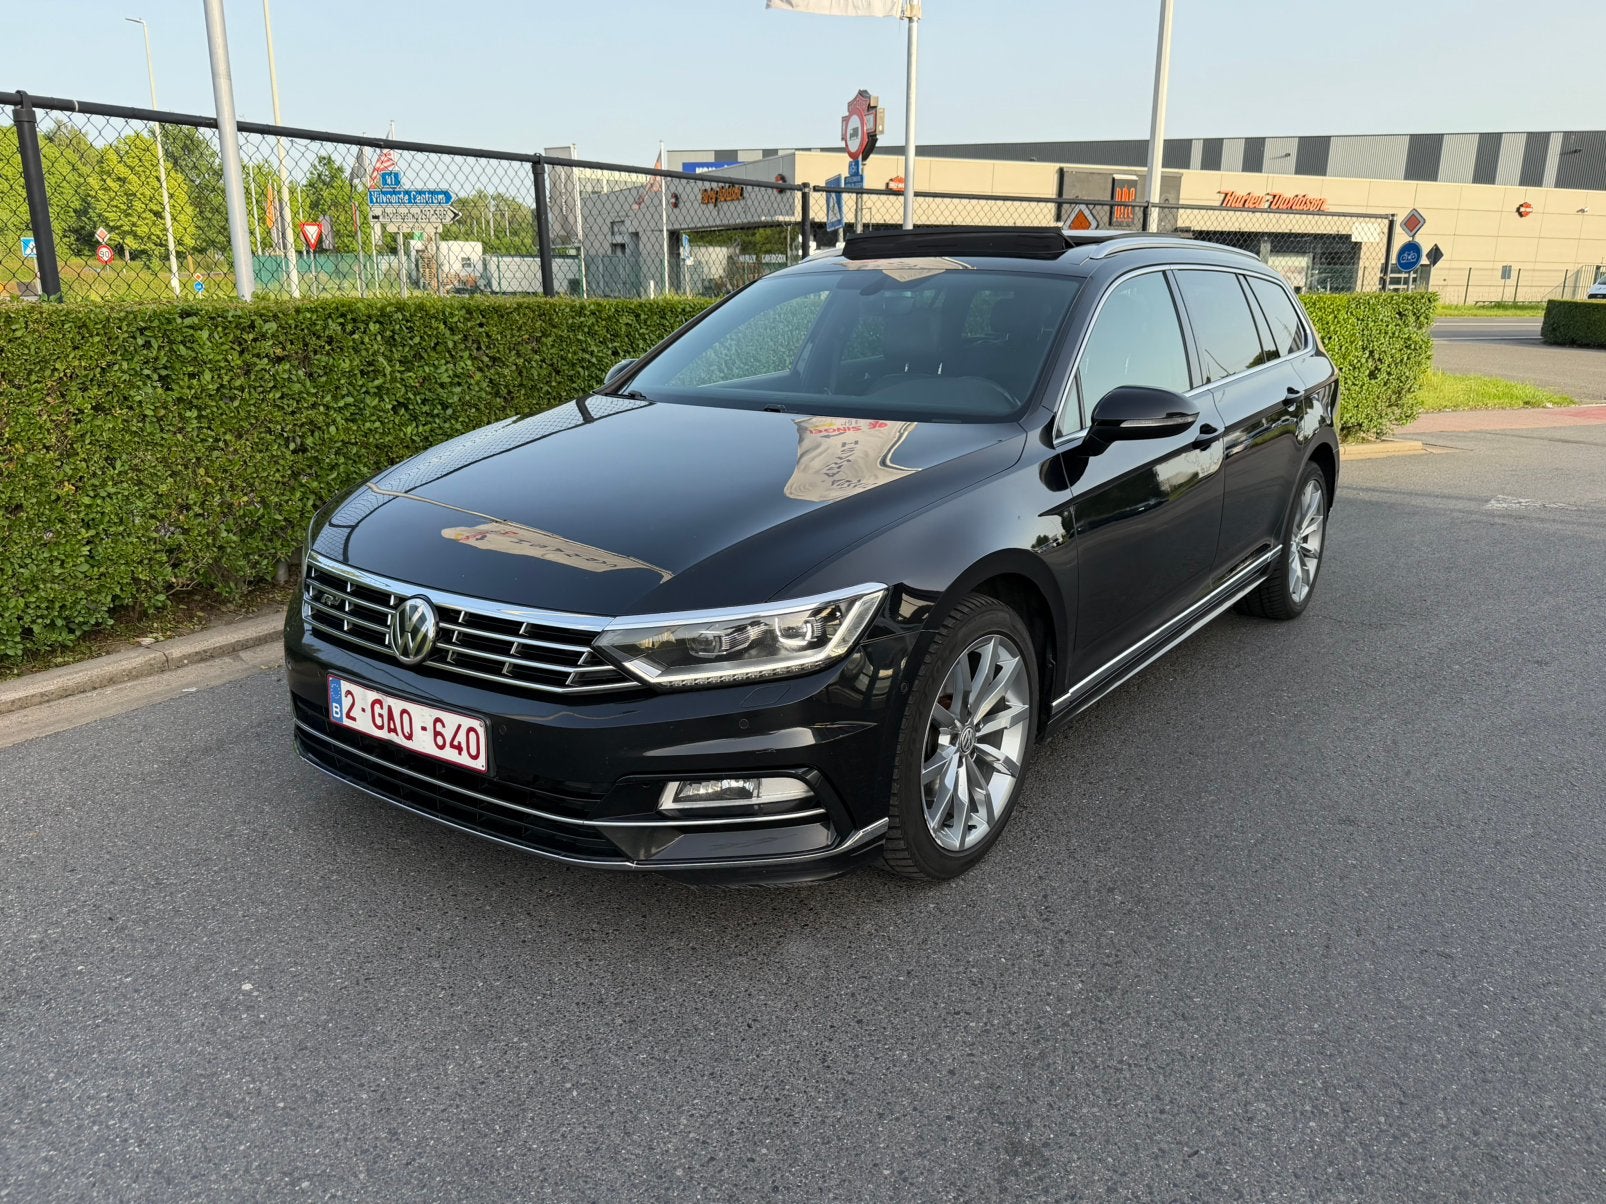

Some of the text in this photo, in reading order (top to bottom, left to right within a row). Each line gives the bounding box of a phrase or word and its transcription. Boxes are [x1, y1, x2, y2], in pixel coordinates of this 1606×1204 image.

[411, 191, 446, 204] Centrum
[100, 250, 110, 259] 90
[332, 702, 341, 718] B
[344, 689, 481, 761] 2-GAQ-640
